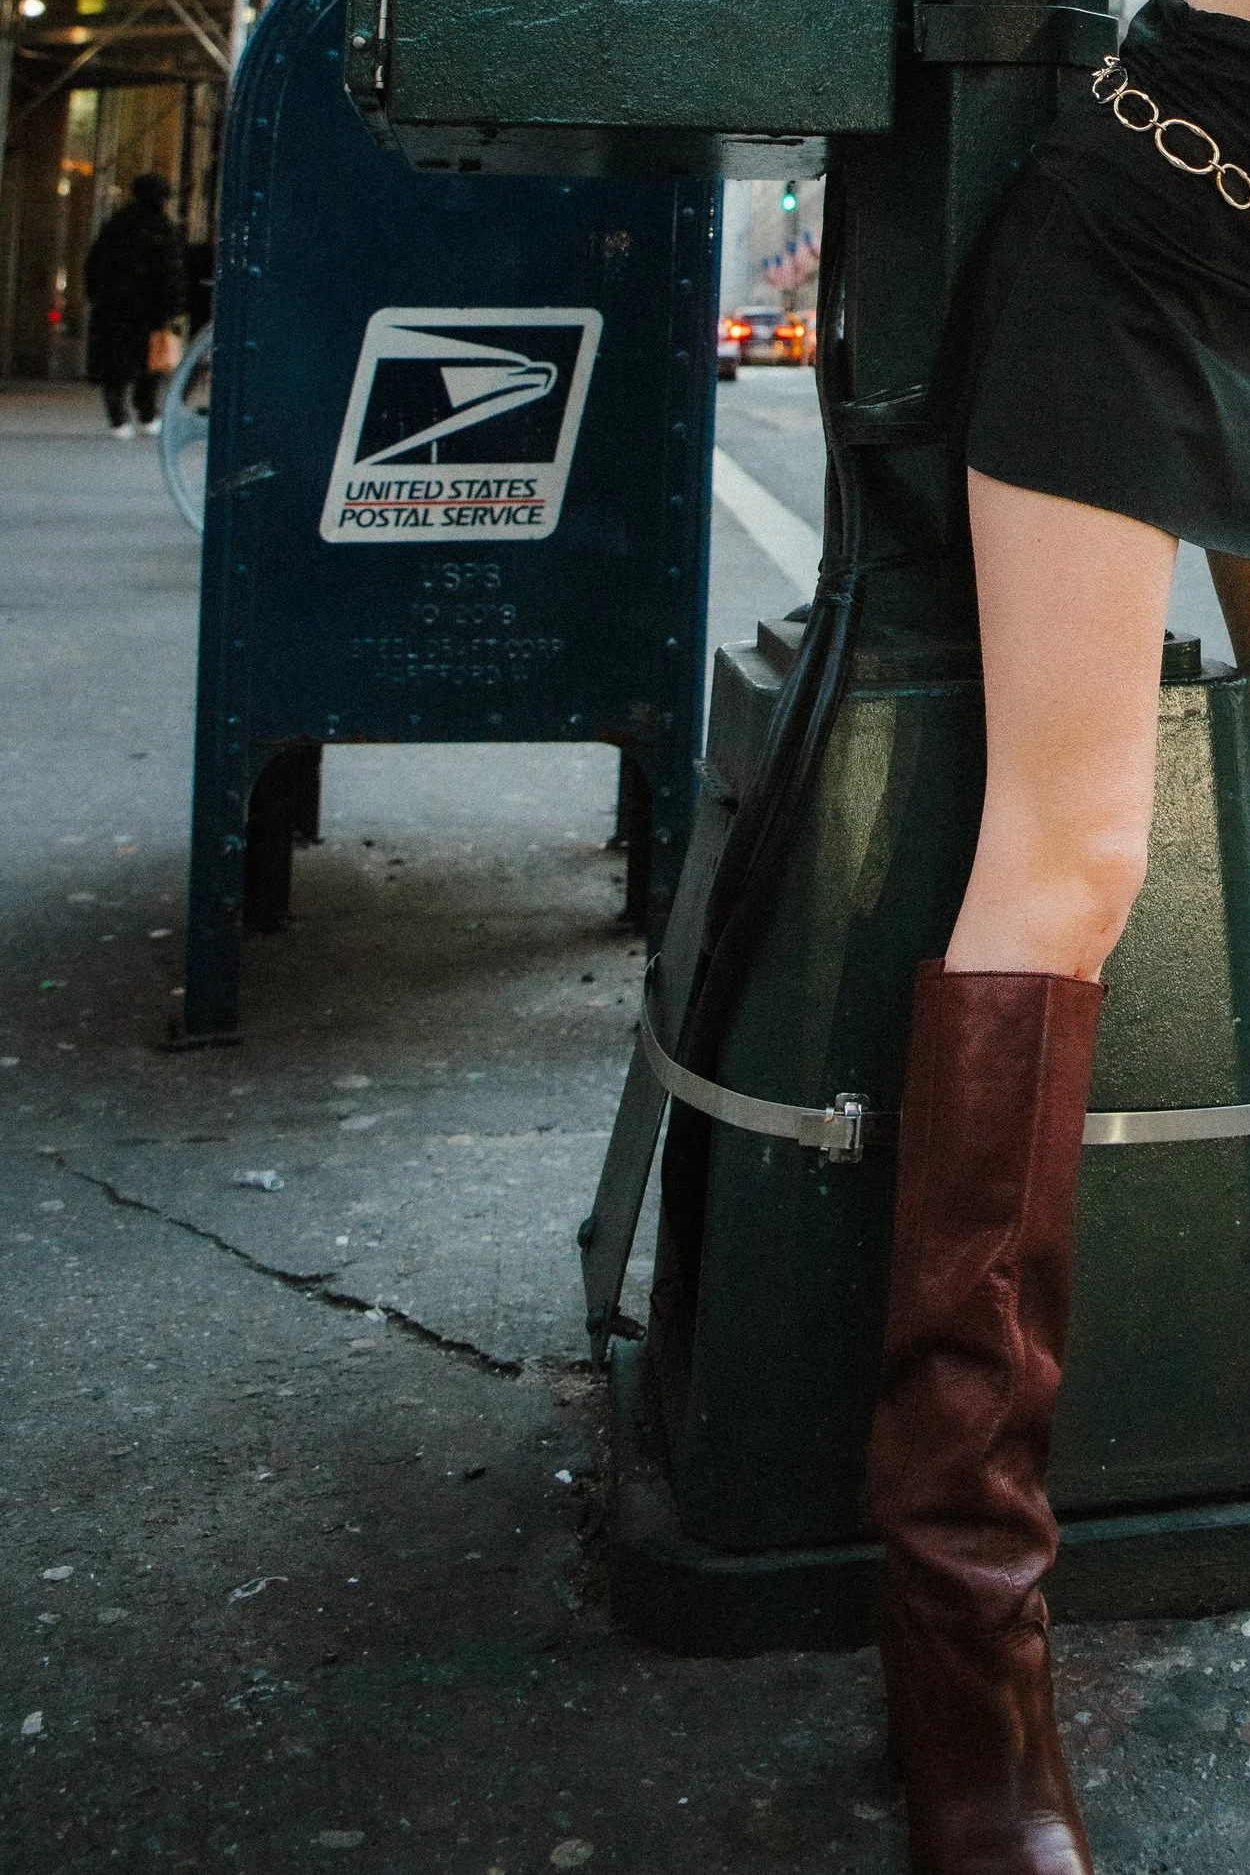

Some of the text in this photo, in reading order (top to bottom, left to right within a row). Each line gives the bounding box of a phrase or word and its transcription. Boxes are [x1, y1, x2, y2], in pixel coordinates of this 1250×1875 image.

[345, 478, 538, 501] UNITED STATES
[339, 505, 546, 528] POSTAL SERVICE
[455, 603, 517, 625] 209
